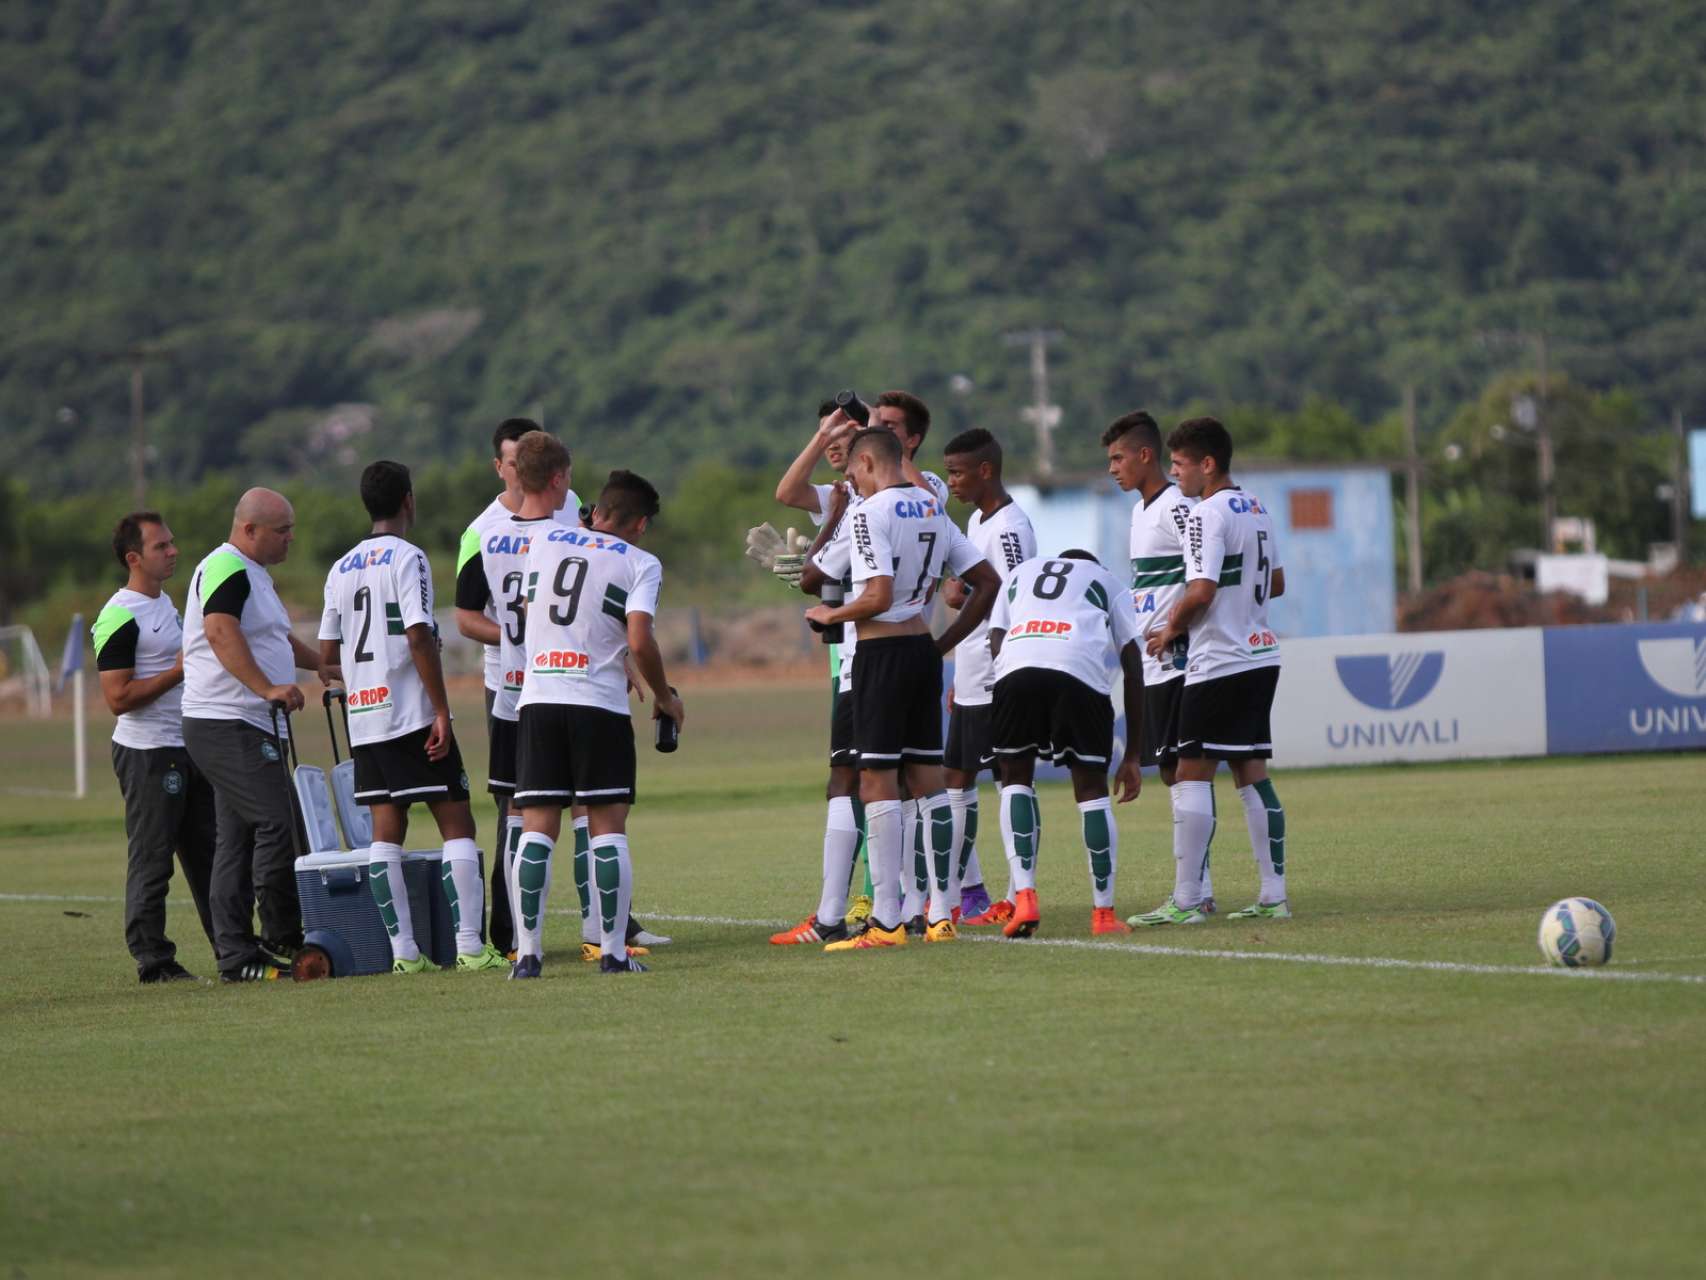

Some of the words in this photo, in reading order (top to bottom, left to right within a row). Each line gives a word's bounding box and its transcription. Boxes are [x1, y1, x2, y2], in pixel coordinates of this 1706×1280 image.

[895, 499, 944, 519] CAIXA
[487, 536, 533, 554] CAIX
[547, 529, 628, 555] CAIXA
[339, 548, 394, 574] CAIXA
[911, 532, 937, 601] 7
[1255, 530, 1270, 606] 5
[549, 556, 589, 626] 9
[1033, 561, 1074, 600] 8
[502, 571, 526, 646] 3
[353, 586, 374, 663] 2
[1025, 620, 1072, 634] RDP
[549, 651, 589, 668] RDP
[360, 687, 389, 706] RDP
[1327, 718, 1459, 749] UNIVALI
